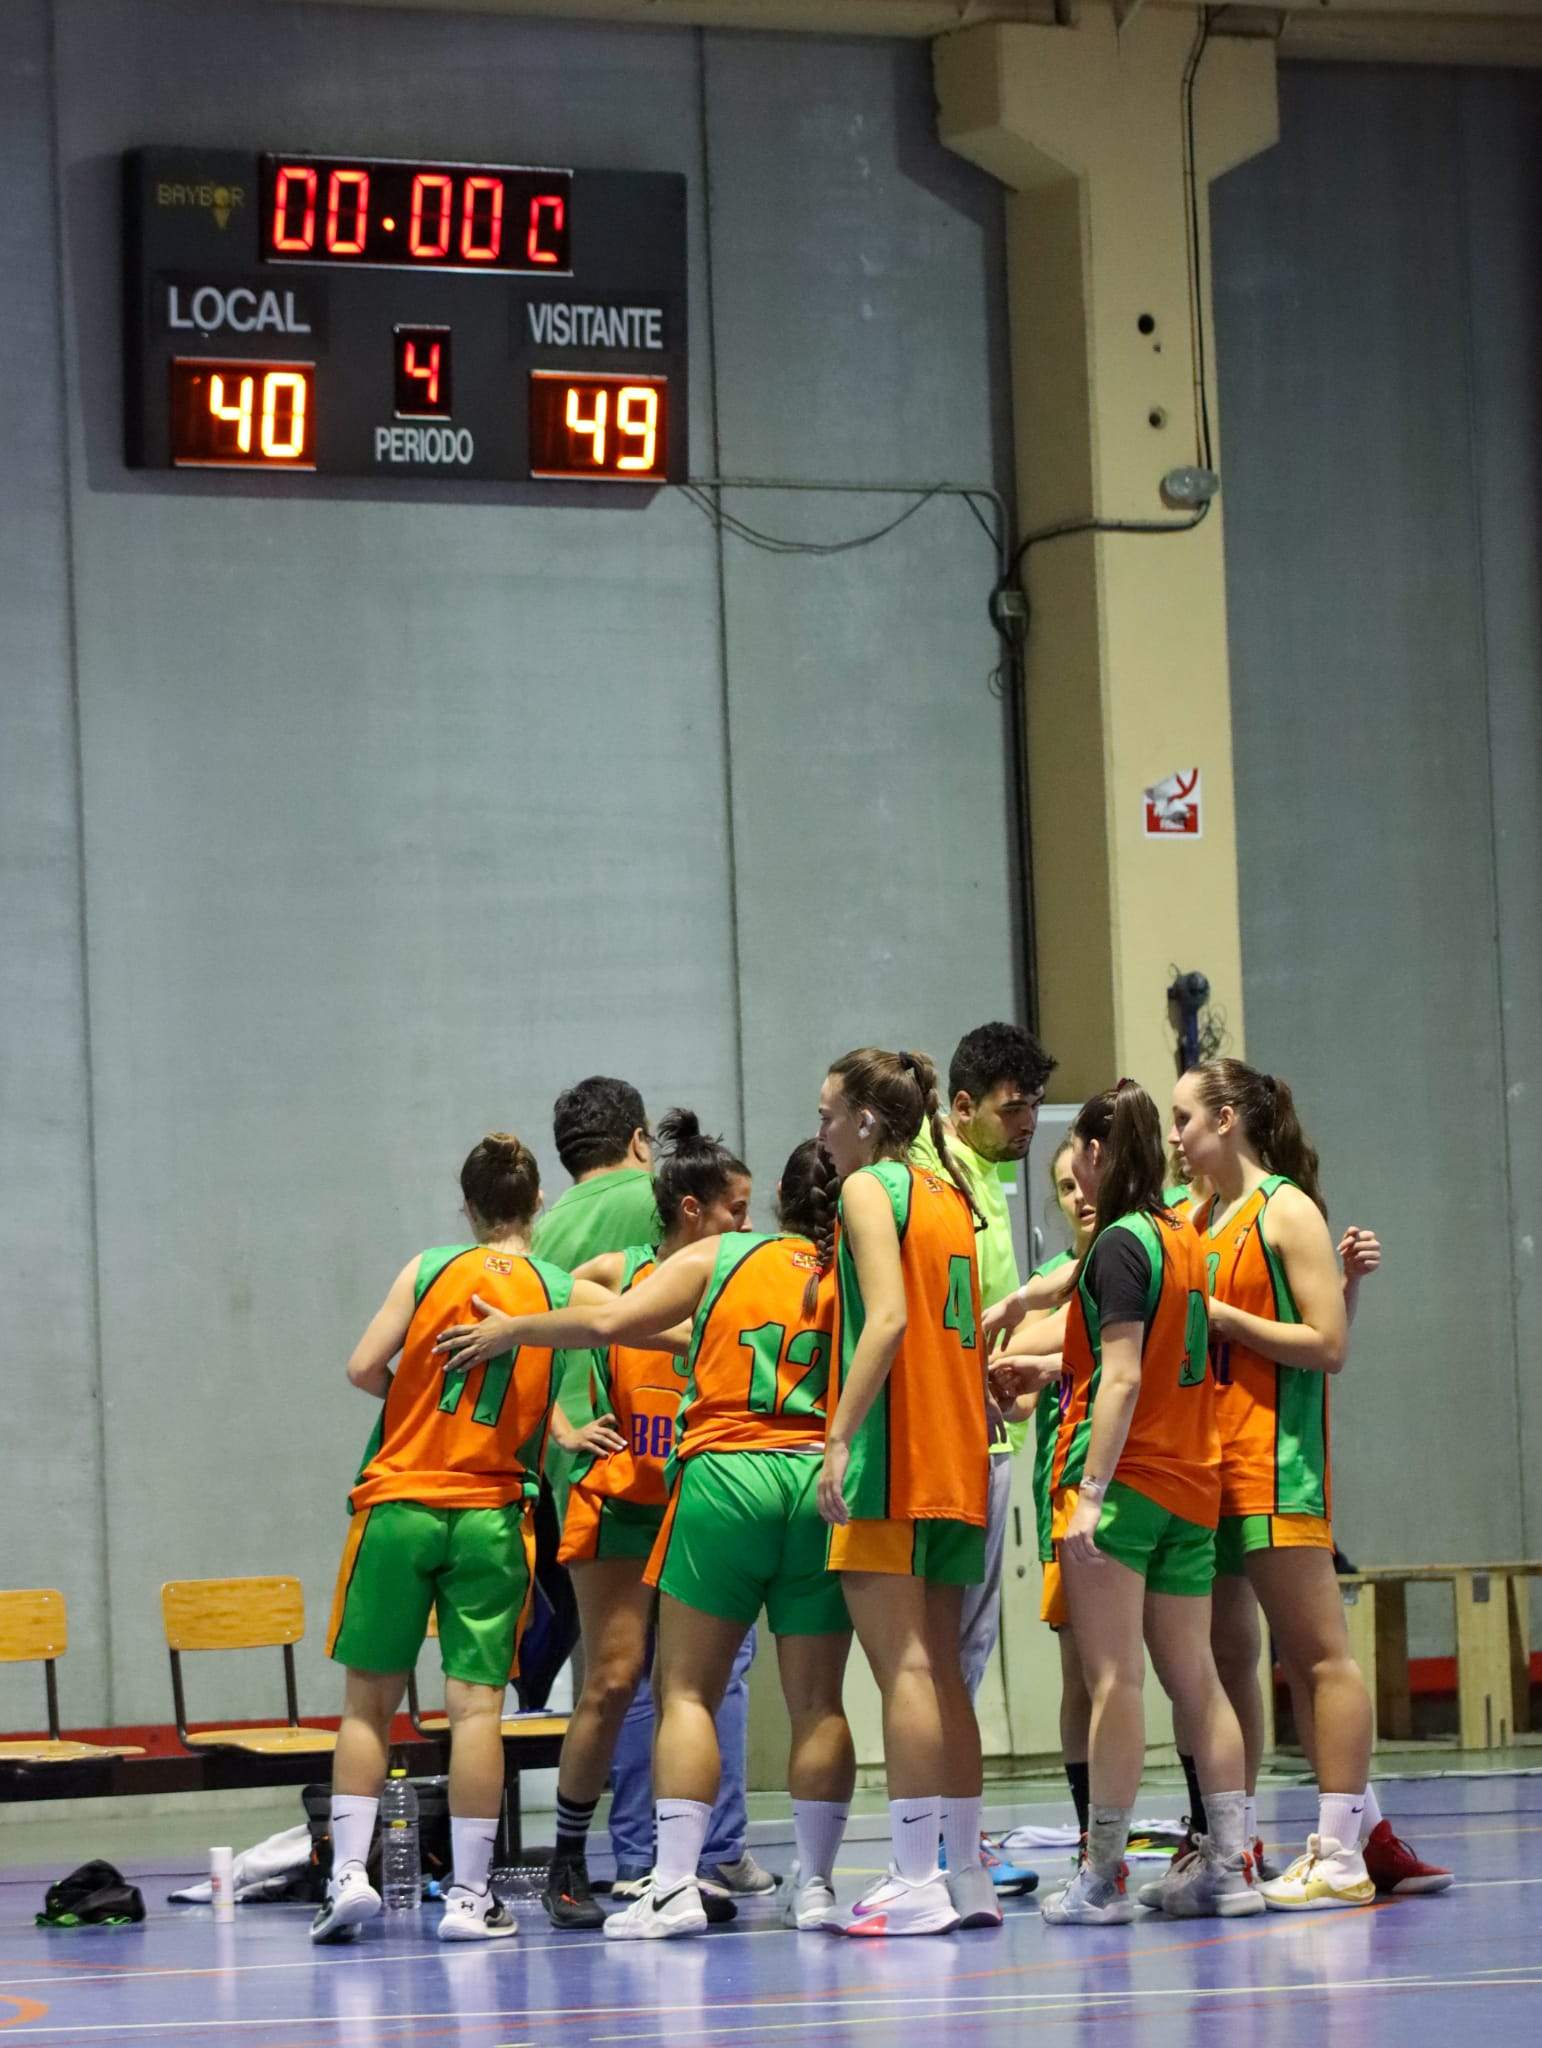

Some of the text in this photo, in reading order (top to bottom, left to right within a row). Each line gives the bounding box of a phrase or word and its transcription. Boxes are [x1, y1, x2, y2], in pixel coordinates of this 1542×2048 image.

[169, 286, 311, 333] LOCAL
[527, 302, 663, 349] VISITANTE
[404, 341, 441, 403] 4
[209, 372, 306, 458] 40
[375, 426, 474, 465] PERIODO
[565, 386, 658, 471] 49
[943, 1255, 976, 1349] 4
[739, 1322, 831, 1419] 12
